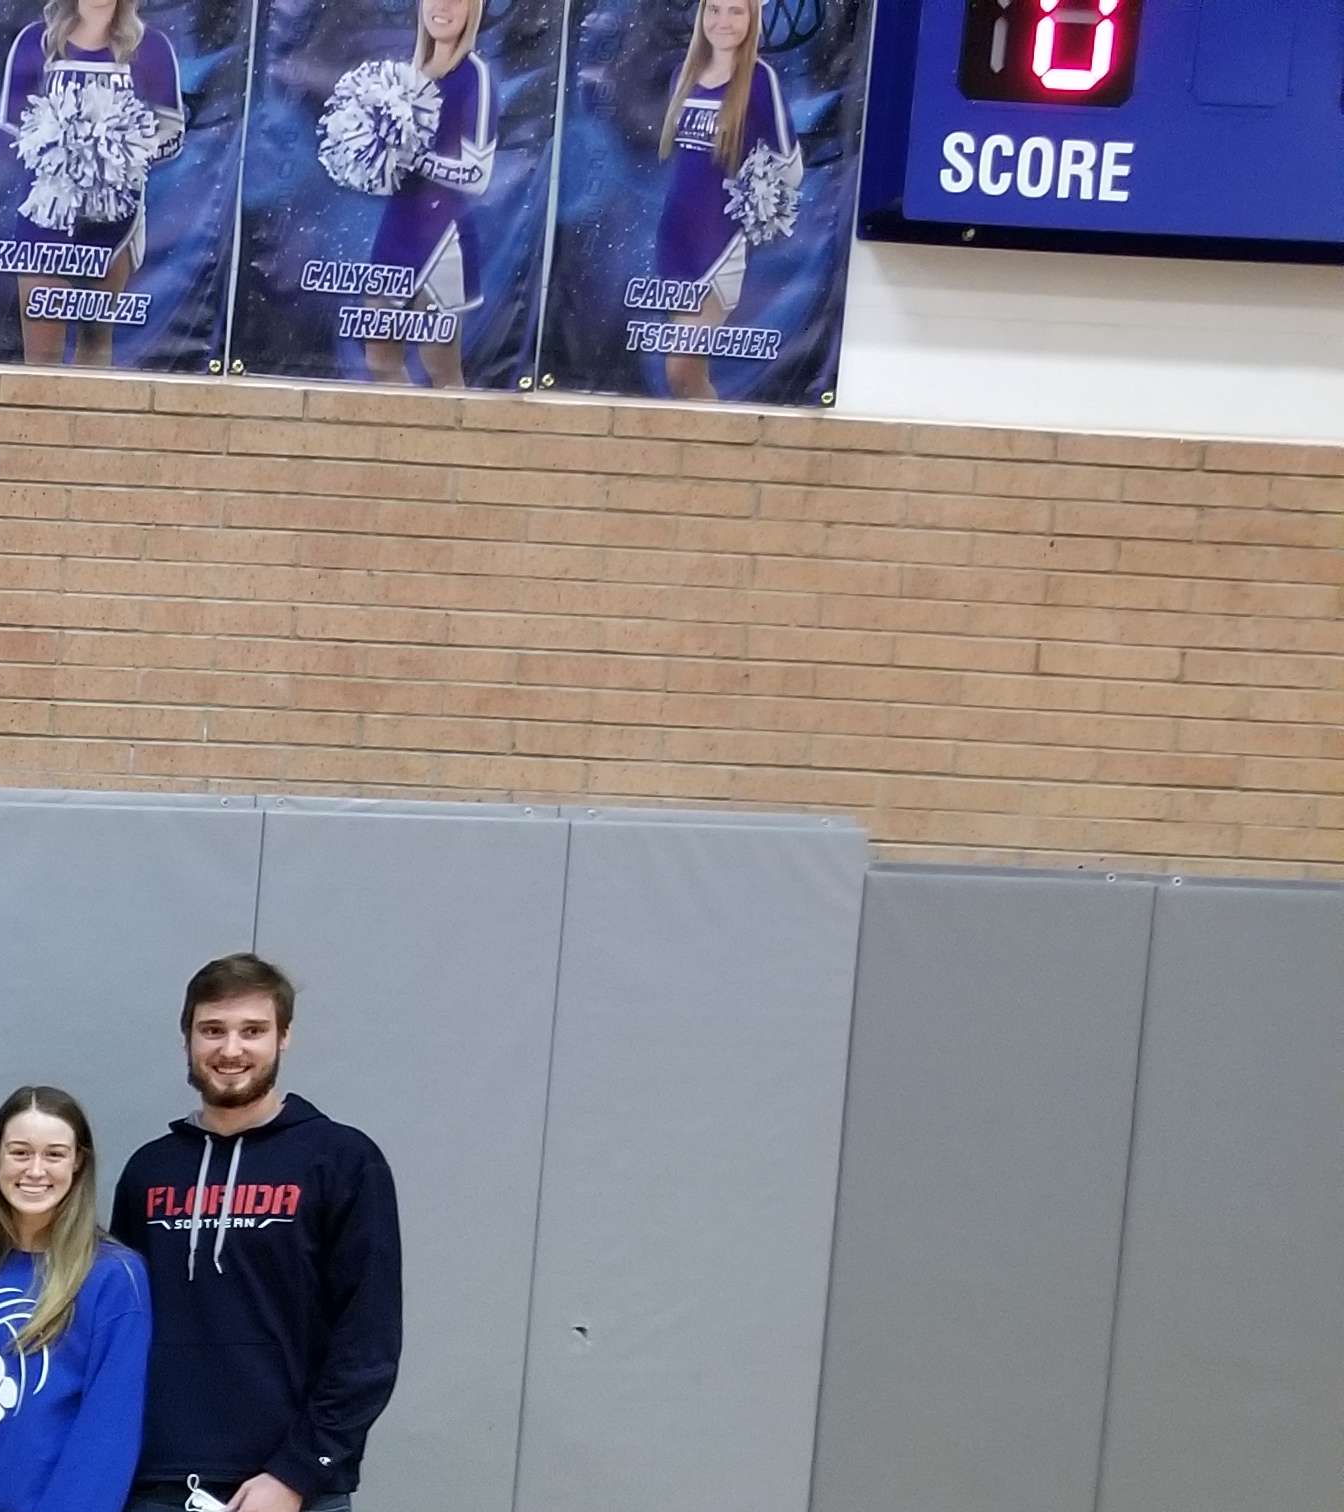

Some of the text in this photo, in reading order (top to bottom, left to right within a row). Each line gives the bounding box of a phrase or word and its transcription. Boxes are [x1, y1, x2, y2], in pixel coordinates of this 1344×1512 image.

[940, 131, 1134, 203] SCORE
[301, 261, 414, 297] CALYSTA
[624, 278, 710, 312] CARLY
[26, 287, 151, 324] SCHULZE
[626, 321, 781, 359] TSCHACHER
[146, 1184, 301, 1217] FLORIDA
